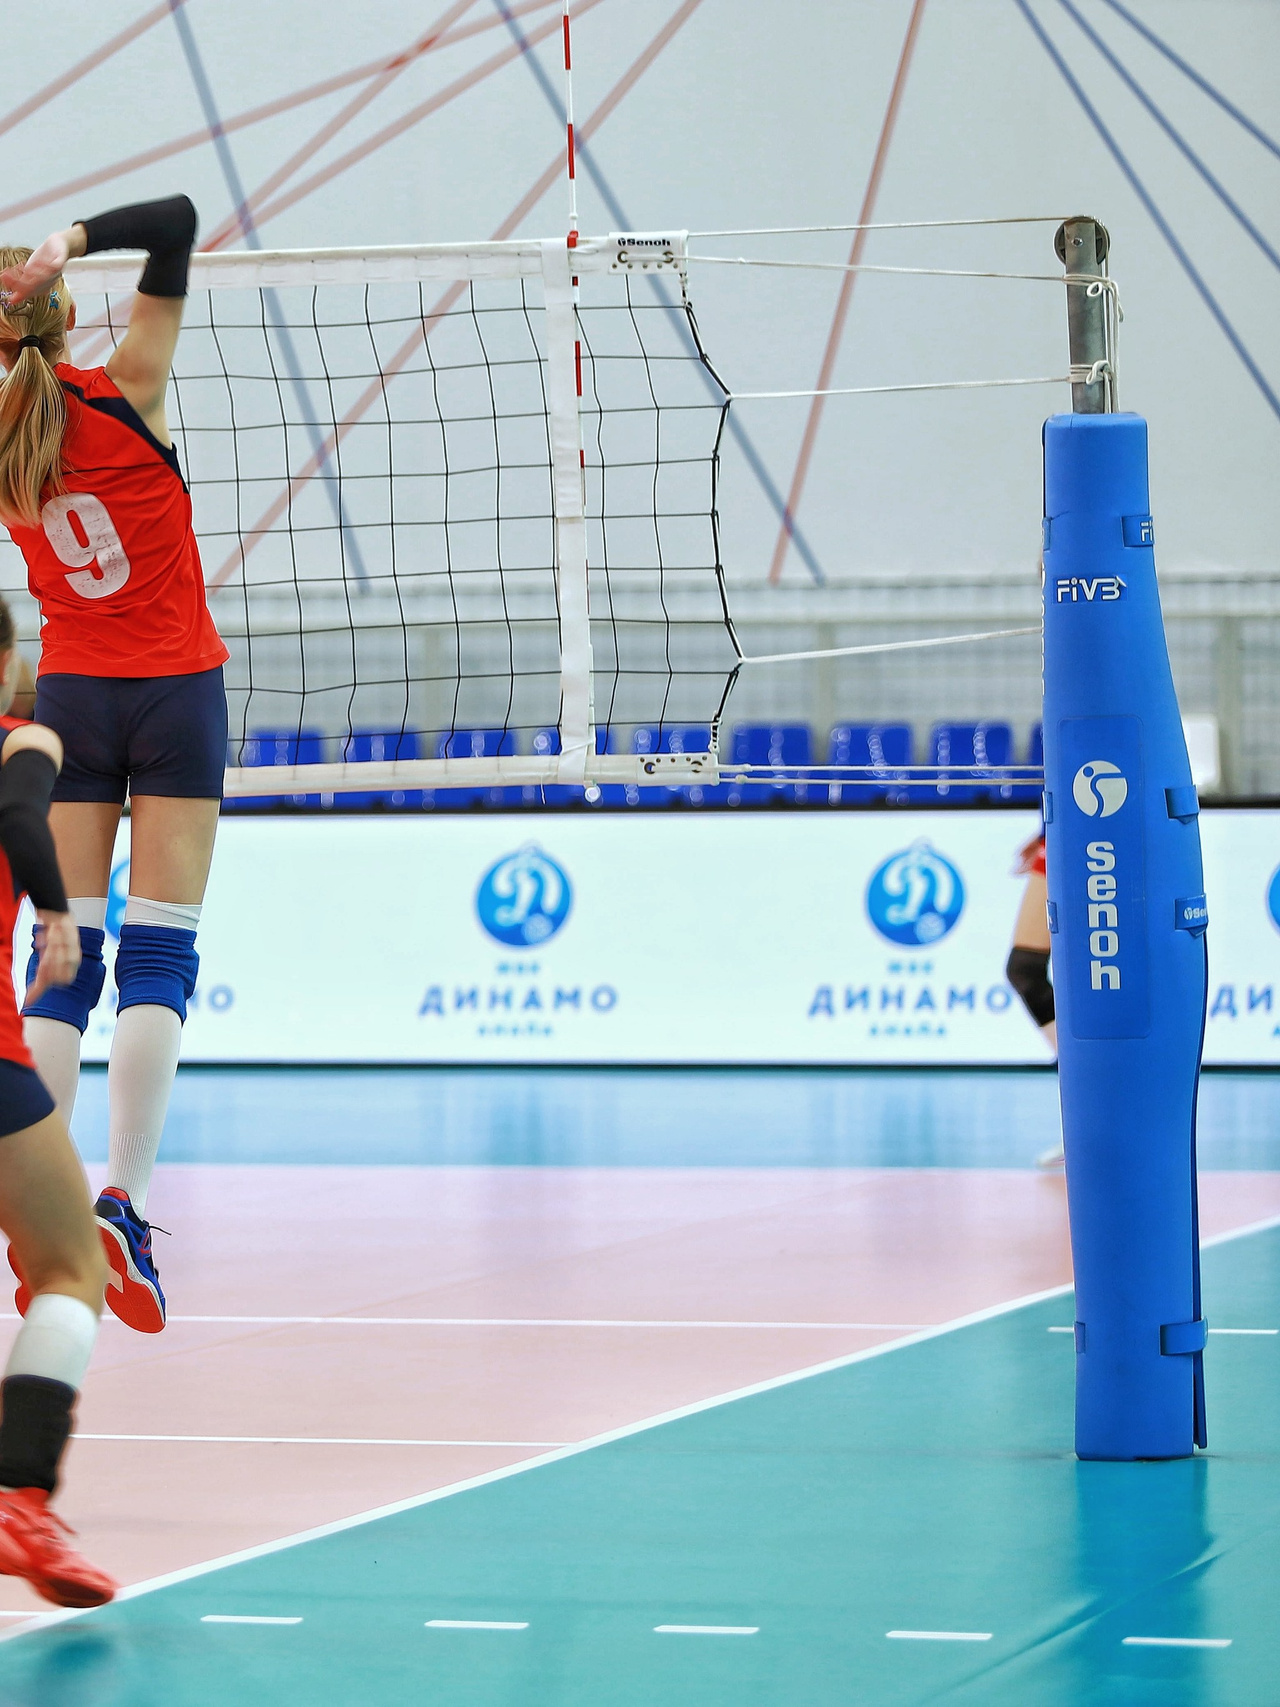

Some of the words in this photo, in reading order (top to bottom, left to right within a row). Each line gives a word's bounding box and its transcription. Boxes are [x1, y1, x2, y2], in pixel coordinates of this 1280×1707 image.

[41, 492, 132, 599] 9
[418, 984, 618, 1017] ДИНАМО
[807, 984, 1013, 1018] ДИНАМО
